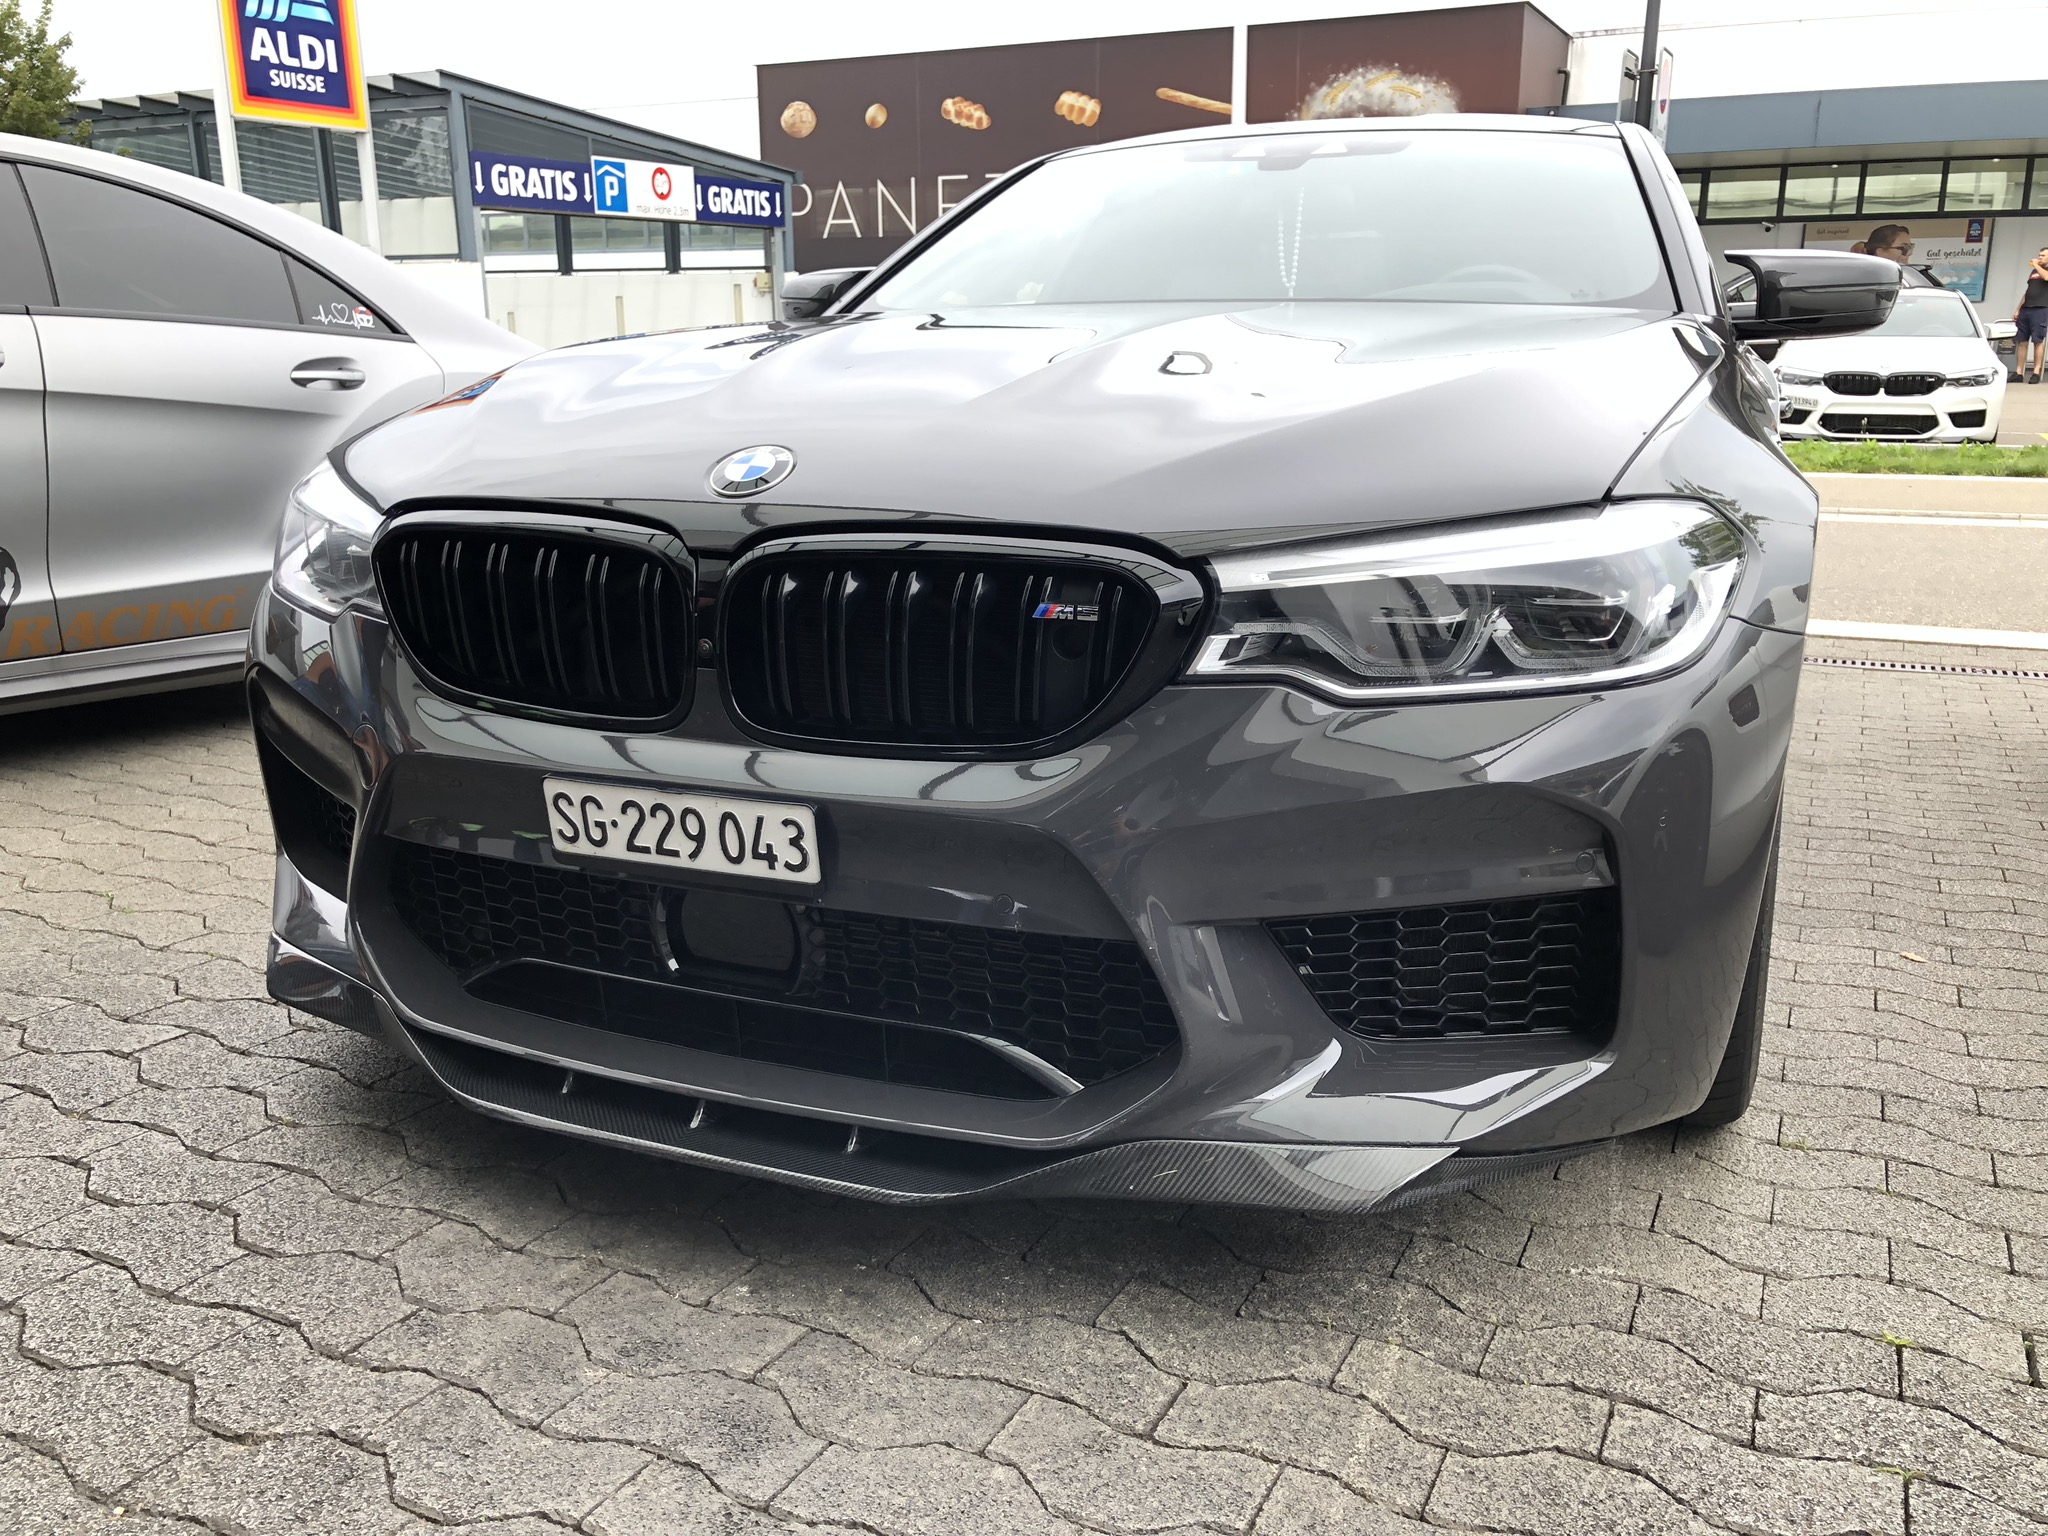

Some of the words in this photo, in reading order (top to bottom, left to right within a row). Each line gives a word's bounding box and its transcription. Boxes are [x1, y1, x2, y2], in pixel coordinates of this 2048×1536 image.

[250, 27, 338, 73] ALDI
[269, 69, 326, 94] SUISSE
[490, 162, 578, 202] GRATIS
[603, 175, 620, 207] P
[707, 184, 772, 218] GRATIS
[791, 173, 1005, 239] PANE
[1926, 249, 1941, 258] Gut
[5, 595, 237, 657] RACING
[1051, 604, 1099, 621] M5
[719, 811, 811, 873] 043
